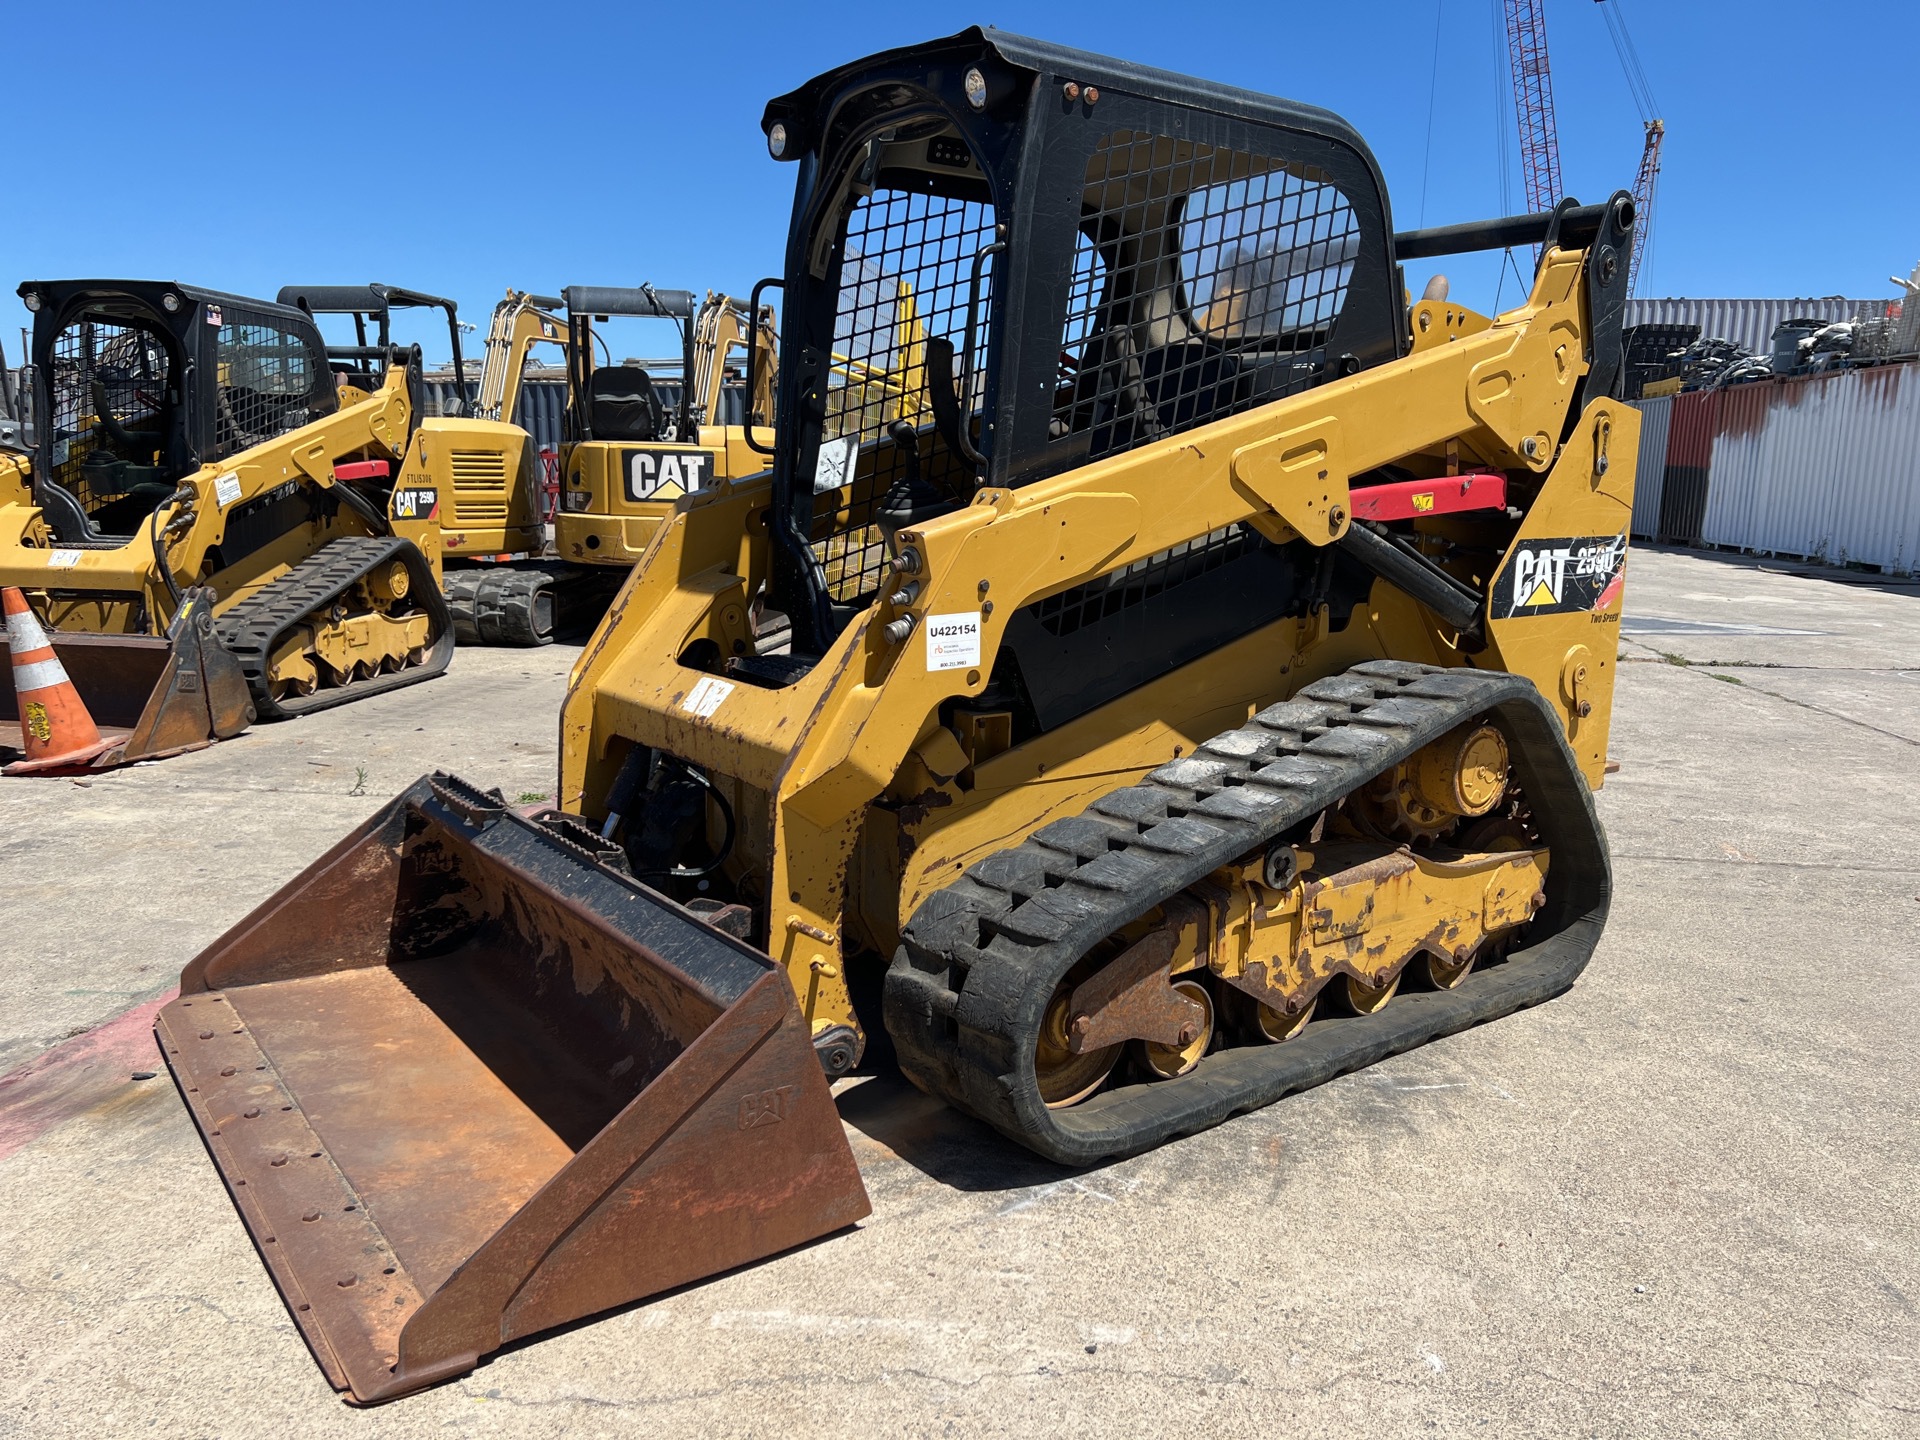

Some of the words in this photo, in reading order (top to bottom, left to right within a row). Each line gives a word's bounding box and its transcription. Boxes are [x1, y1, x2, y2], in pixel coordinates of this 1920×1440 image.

[631, 453, 705, 500] CAT
[396, 491, 417, 517] CAT
[418, 491, 435, 504] 259D
[1513, 549, 1571, 608] CAT
[1576, 546, 1616, 575] 259D
[930, 623, 976, 638] U422154
[737, 1085, 793, 1131] CAT
